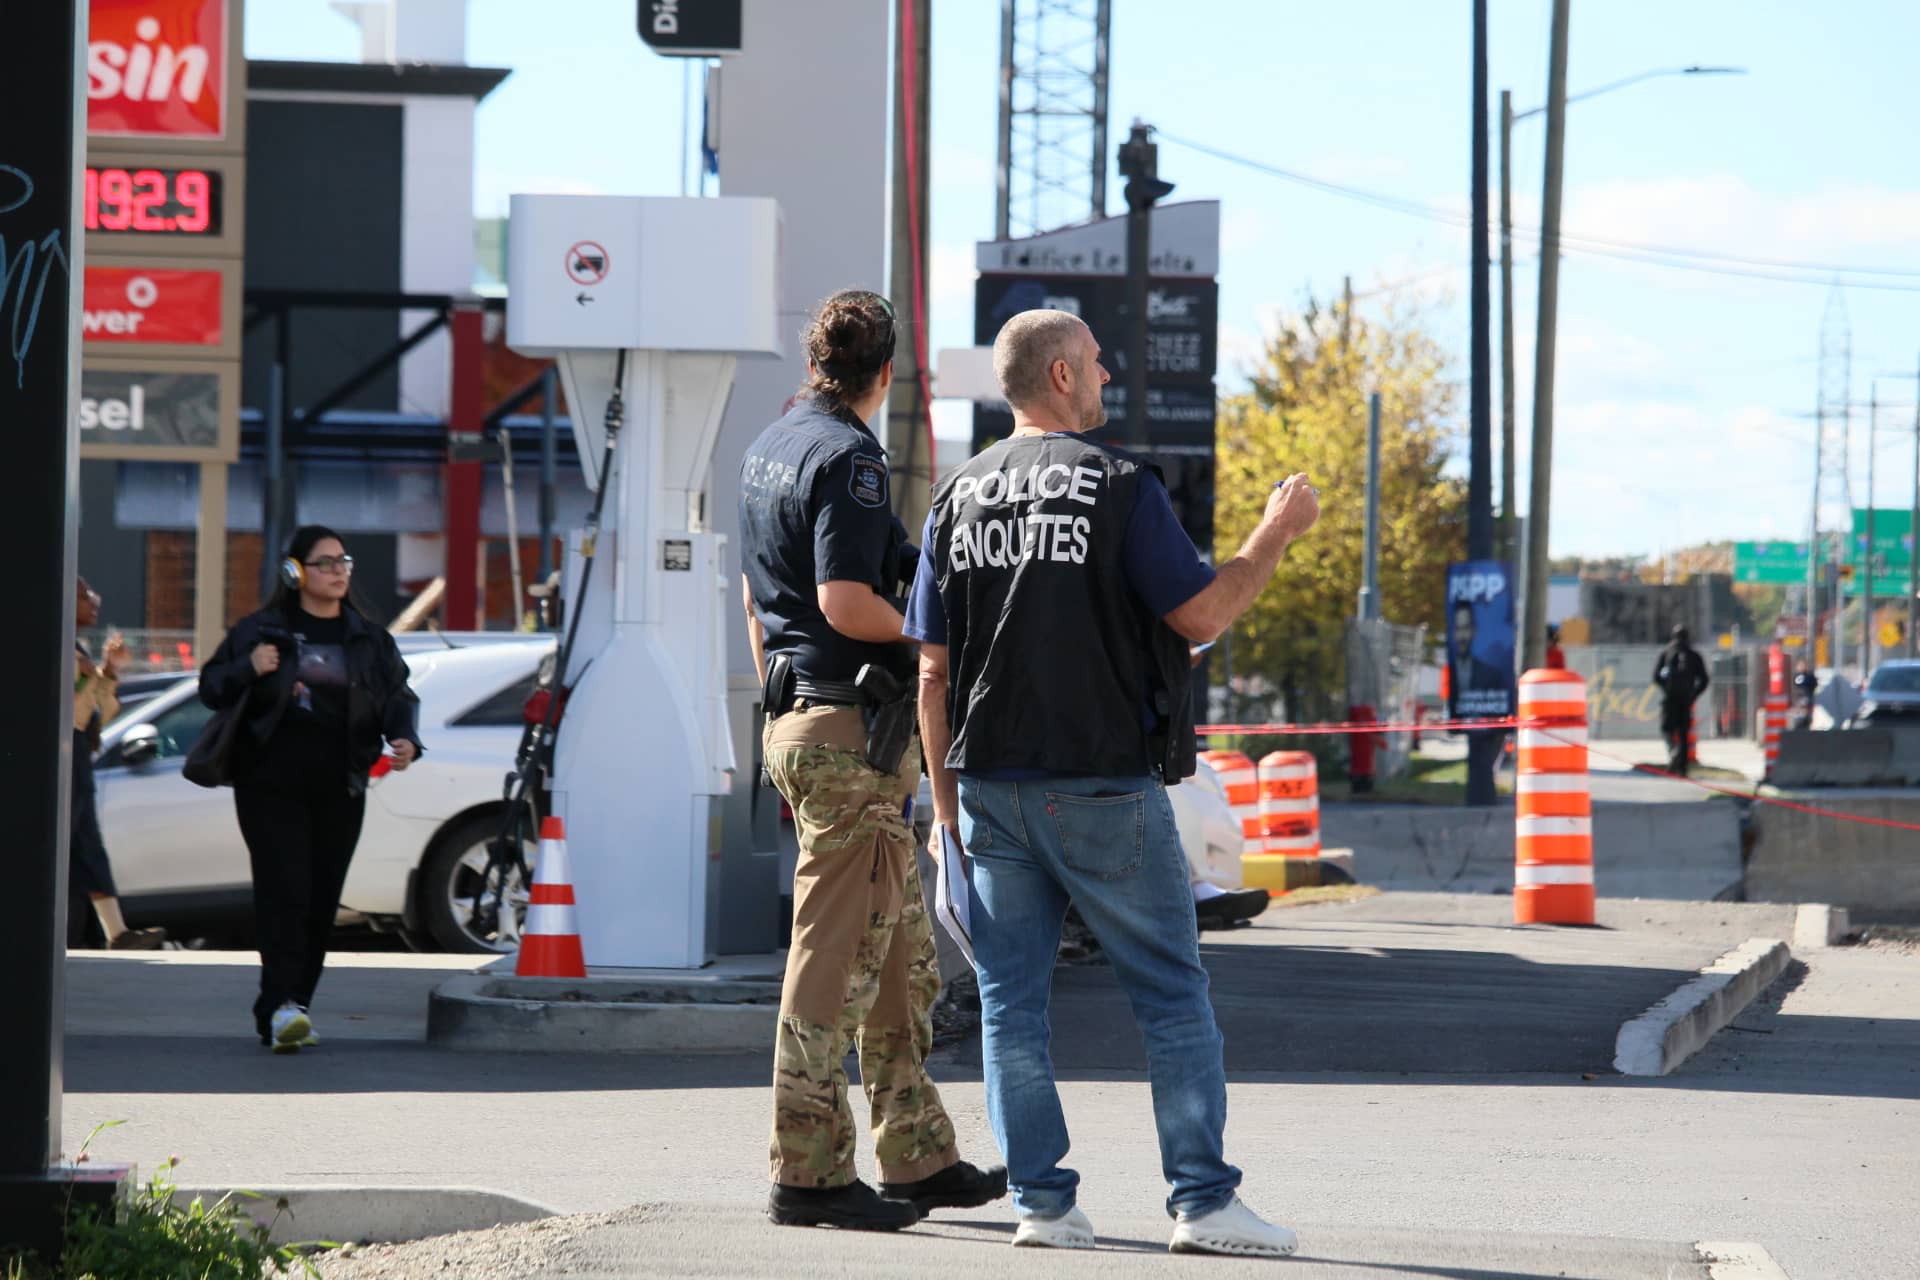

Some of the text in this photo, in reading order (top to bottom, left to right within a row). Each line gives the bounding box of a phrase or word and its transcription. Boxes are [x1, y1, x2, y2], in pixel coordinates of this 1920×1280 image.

[652, 0, 679, 34] Di
[85, 168, 210, 232] 192.9
[951, 463, 1104, 514] POLICE
